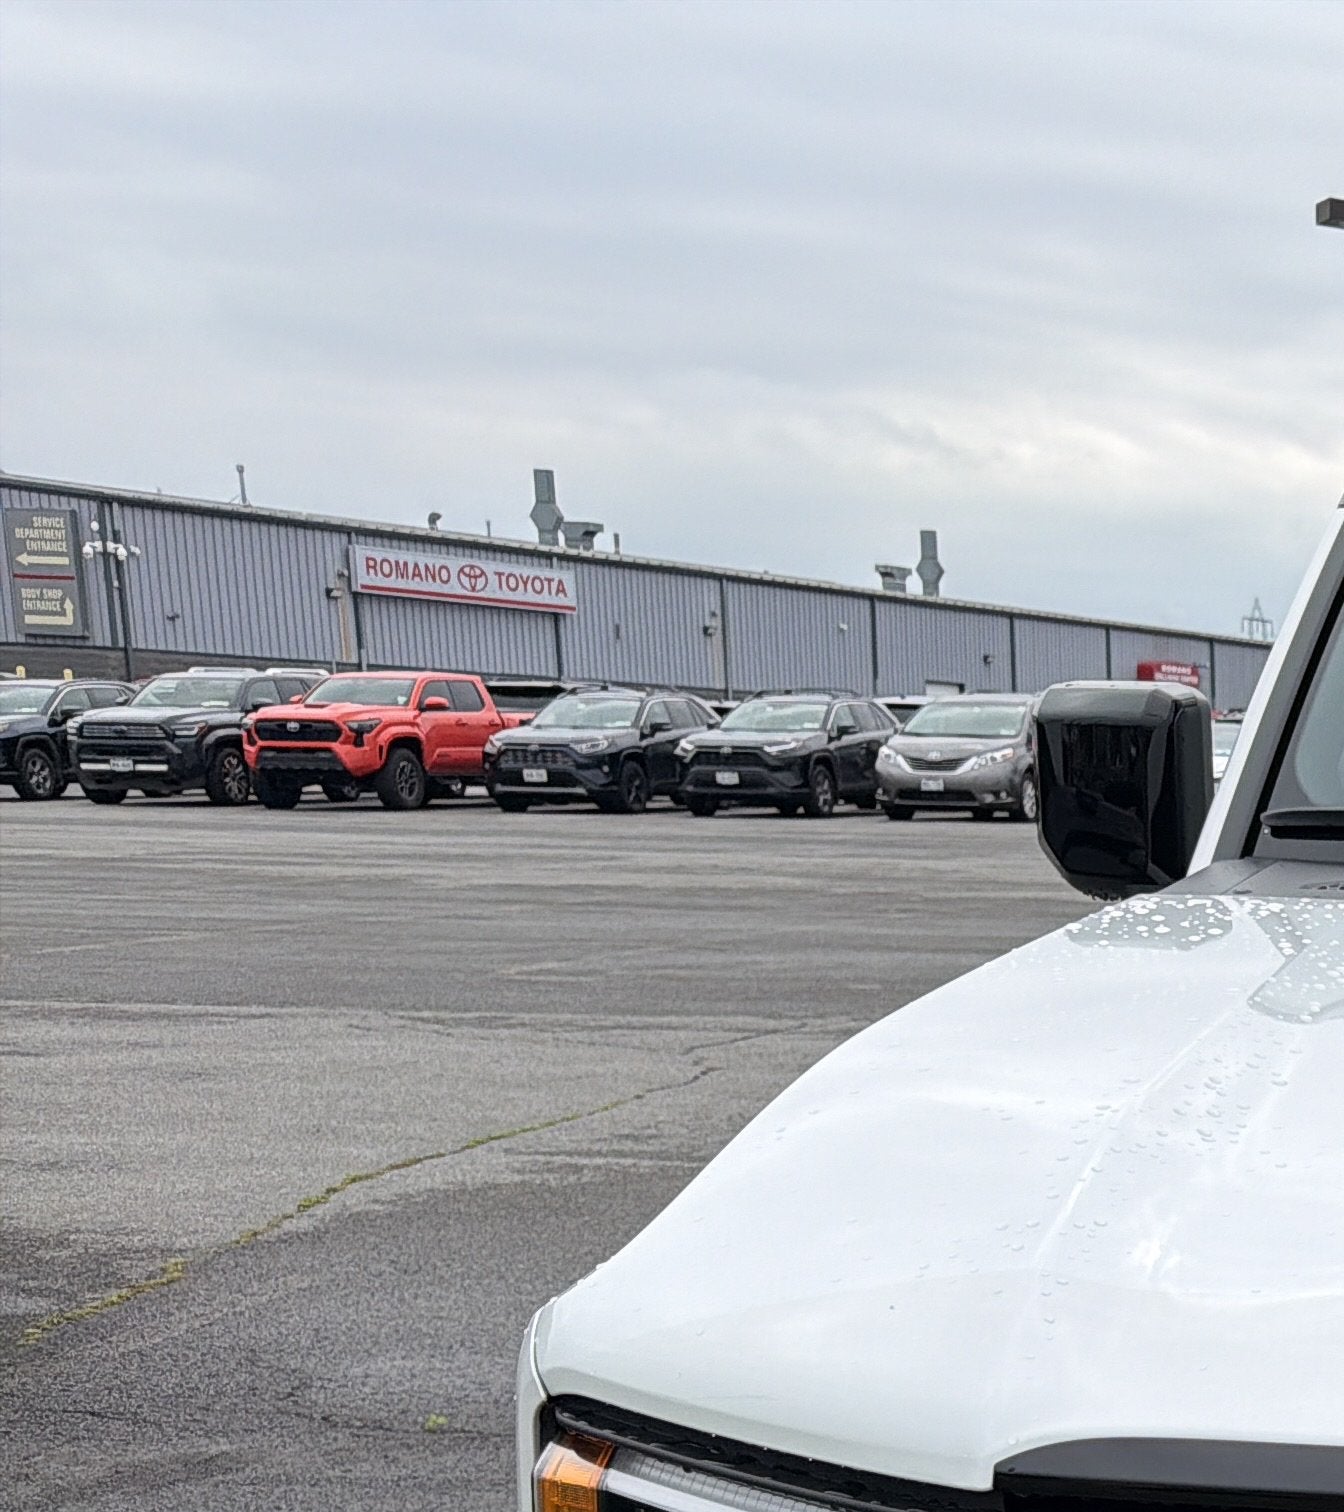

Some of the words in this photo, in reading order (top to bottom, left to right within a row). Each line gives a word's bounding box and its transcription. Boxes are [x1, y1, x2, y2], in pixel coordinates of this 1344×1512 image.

[32, 516, 65, 528] SERVICE
[15, 527, 66, 540] DEPARTMENT
[26, 540, 68, 552] ENTRANCE
[365, 556, 451, 585] ROMANO
[494, 570, 568, 598] TOYOTA
[22, 599, 61, 611] ENTRANCE
